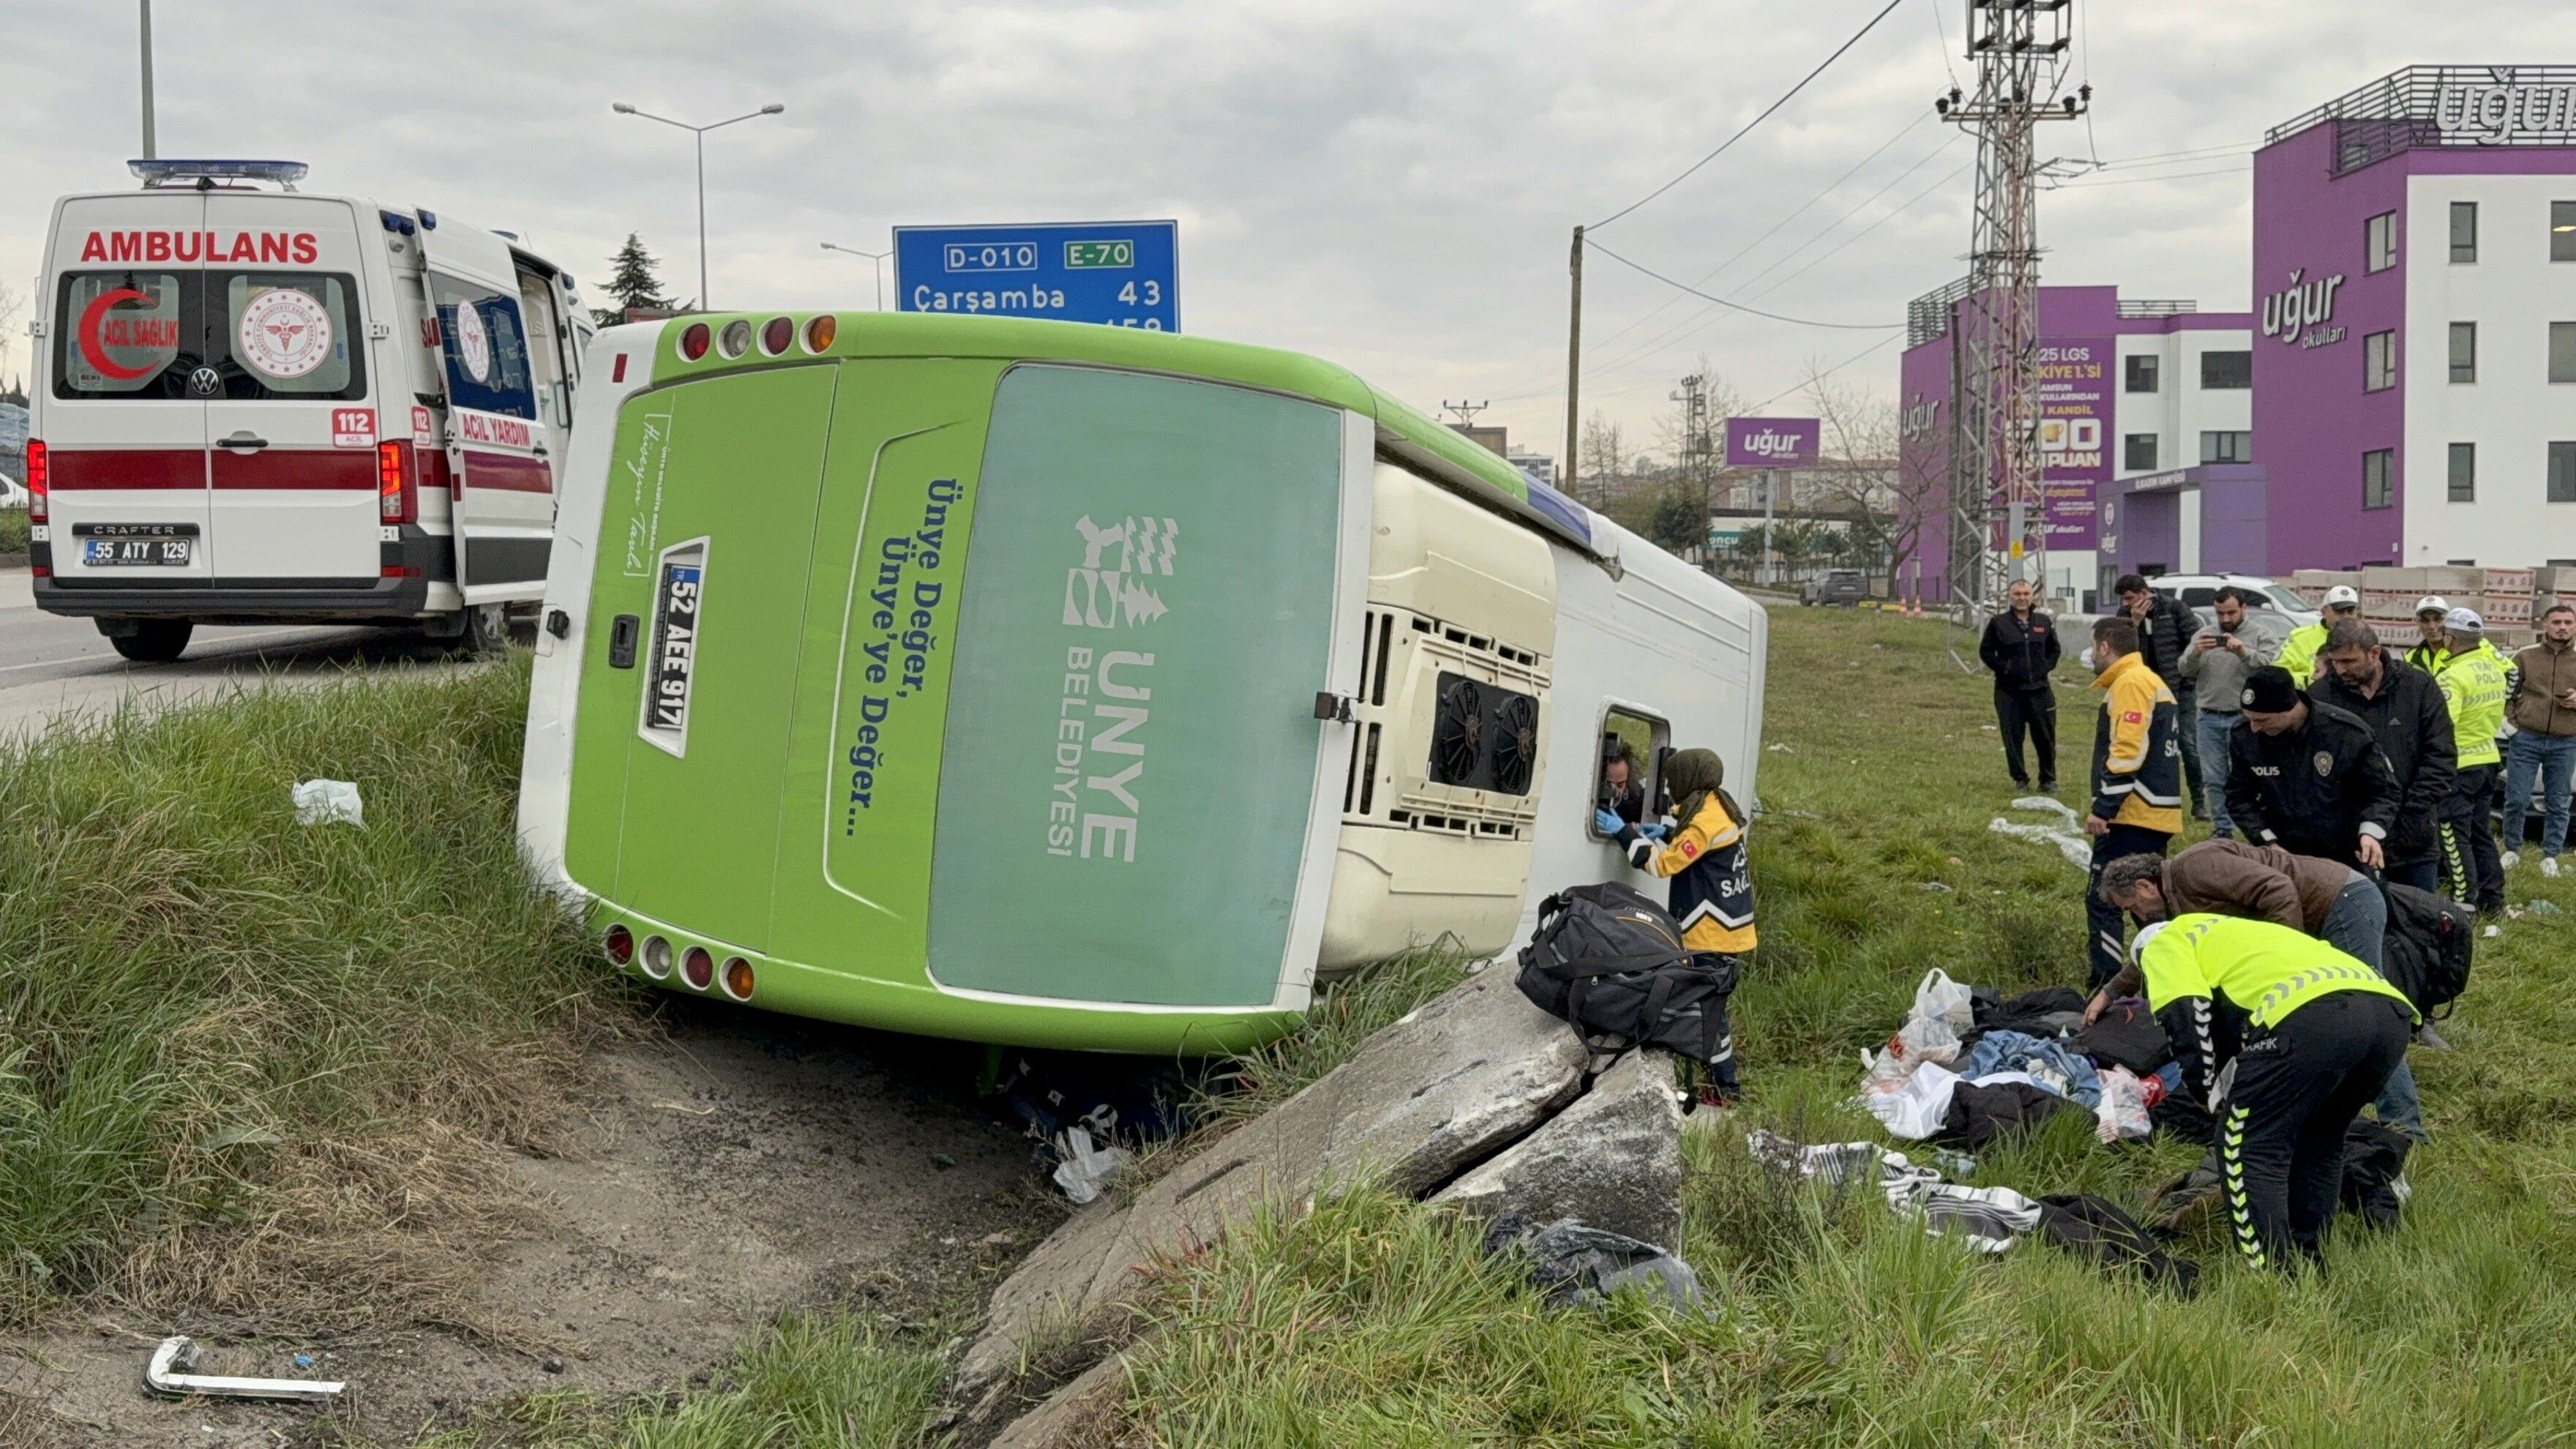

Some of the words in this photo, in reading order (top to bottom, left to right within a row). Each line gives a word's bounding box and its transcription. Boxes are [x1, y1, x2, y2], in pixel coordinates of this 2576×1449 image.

[80, 231, 318, 263] AMBULANS
[950, 246, 1033, 269] D-010
[1069, 243, 1130, 266] E-70
[914, 282, 1066, 312] Çarşamba
[1117, 280, 1161, 306] 43
[2263, 269, 2344, 343] uğur
[133, 316, 178, 347] SAĞLIK
[2302, 326, 2345, 349] okulları
[2062, 348, 2089, 362] LGS
[338, 412, 370, 432] 112
[413, 410, 429, 430] 112
[463, 413, 490, 441] ACİL
[490, 418, 531, 448] YARDIM
[1744, 427, 1802, 456] uğur
[2048, 452, 2102, 468] PUAN
[94, 526, 174, 535] CRAFTER
[916, 478, 964, 570] Ünye
[95, 542, 114, 559] 55
[121, 542, 151, 559] ATY
[162, 542, 187, 559] 129
[670, 582, 697, 614] 52
[863, 536, 918, 684] Ünye'ye
[662, 624, 692, 673] AEE
[895, 580, 943, 700] Değer,
[657, 679, 685, 726] 917
